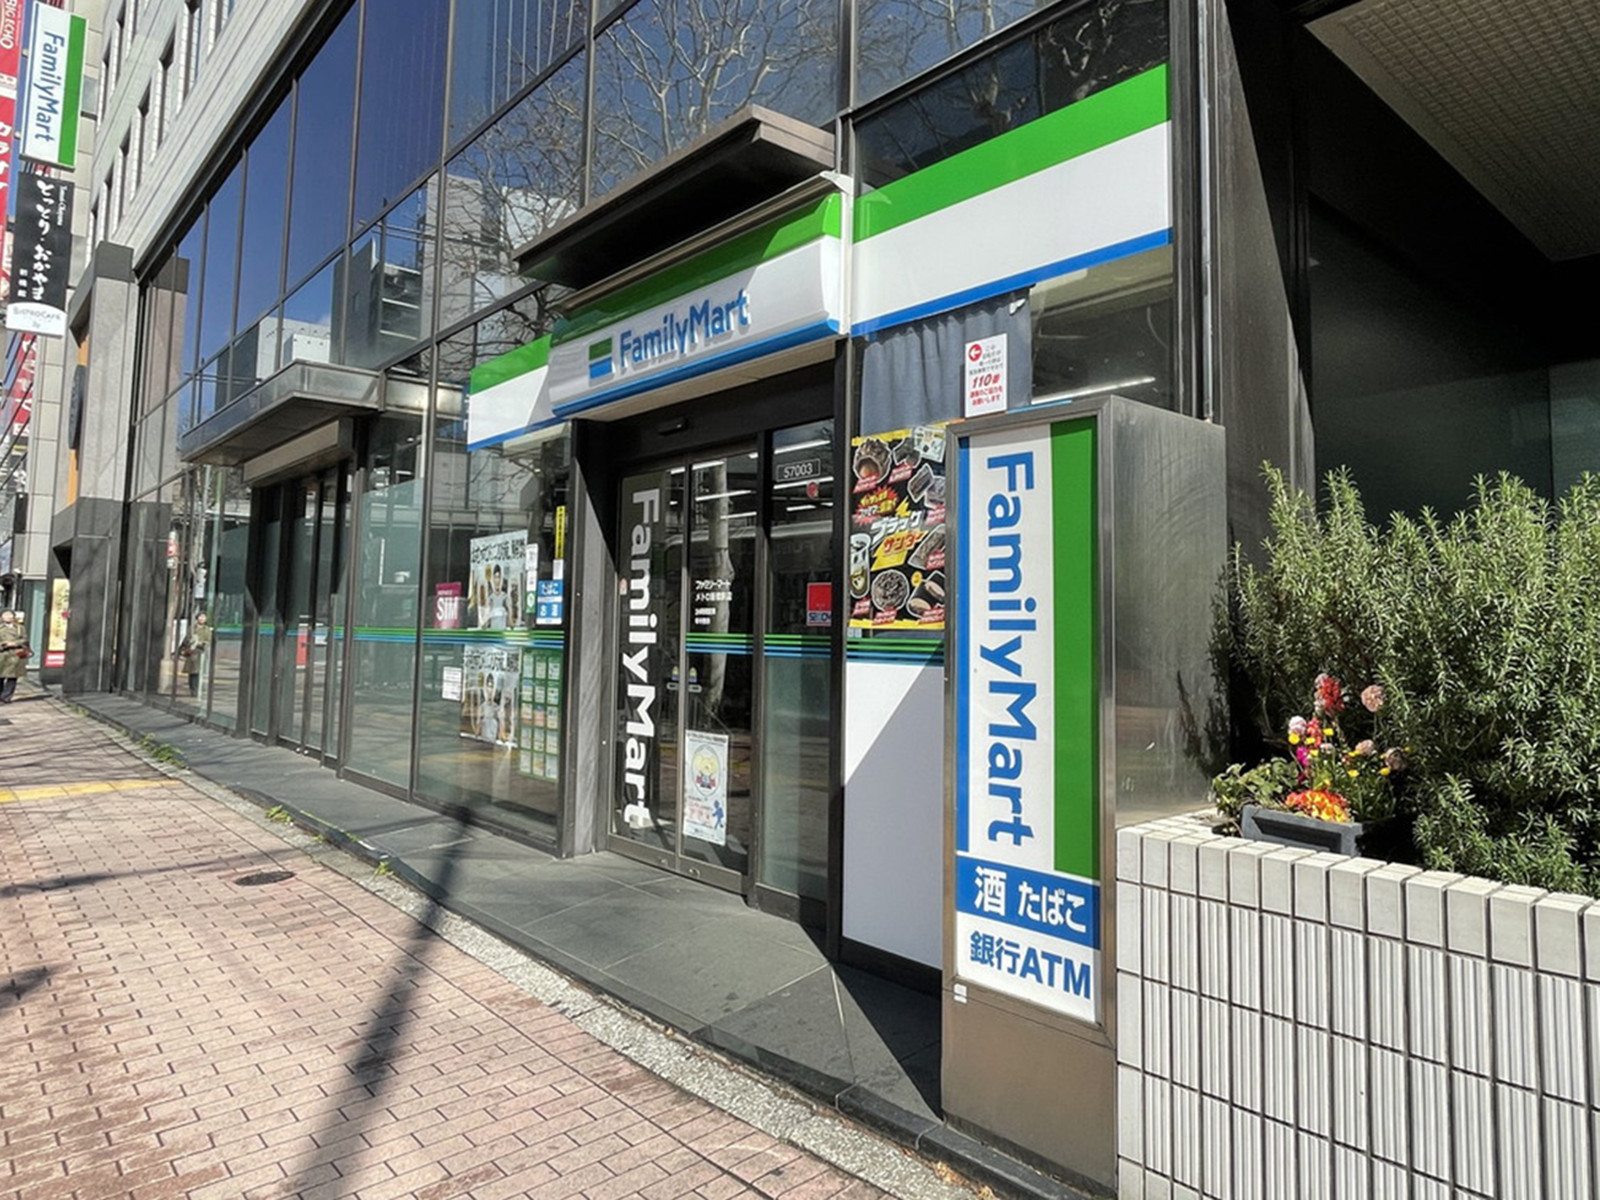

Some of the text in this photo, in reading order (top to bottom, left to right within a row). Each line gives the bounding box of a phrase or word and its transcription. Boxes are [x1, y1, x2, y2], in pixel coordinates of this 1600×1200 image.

[33, 30, 65, 142] FamilyMart
[619, 288, 748, 366] FamilyMart
[784, 463, 812, 479] 57003
[622, 488, 660, 828] FamilyMart
[980, 451, 1037, 846] FamilyMart
[974, 865, 1087, 933] 酒 たばこ
[970, 930, 1091, 1000] 銀行ATM
